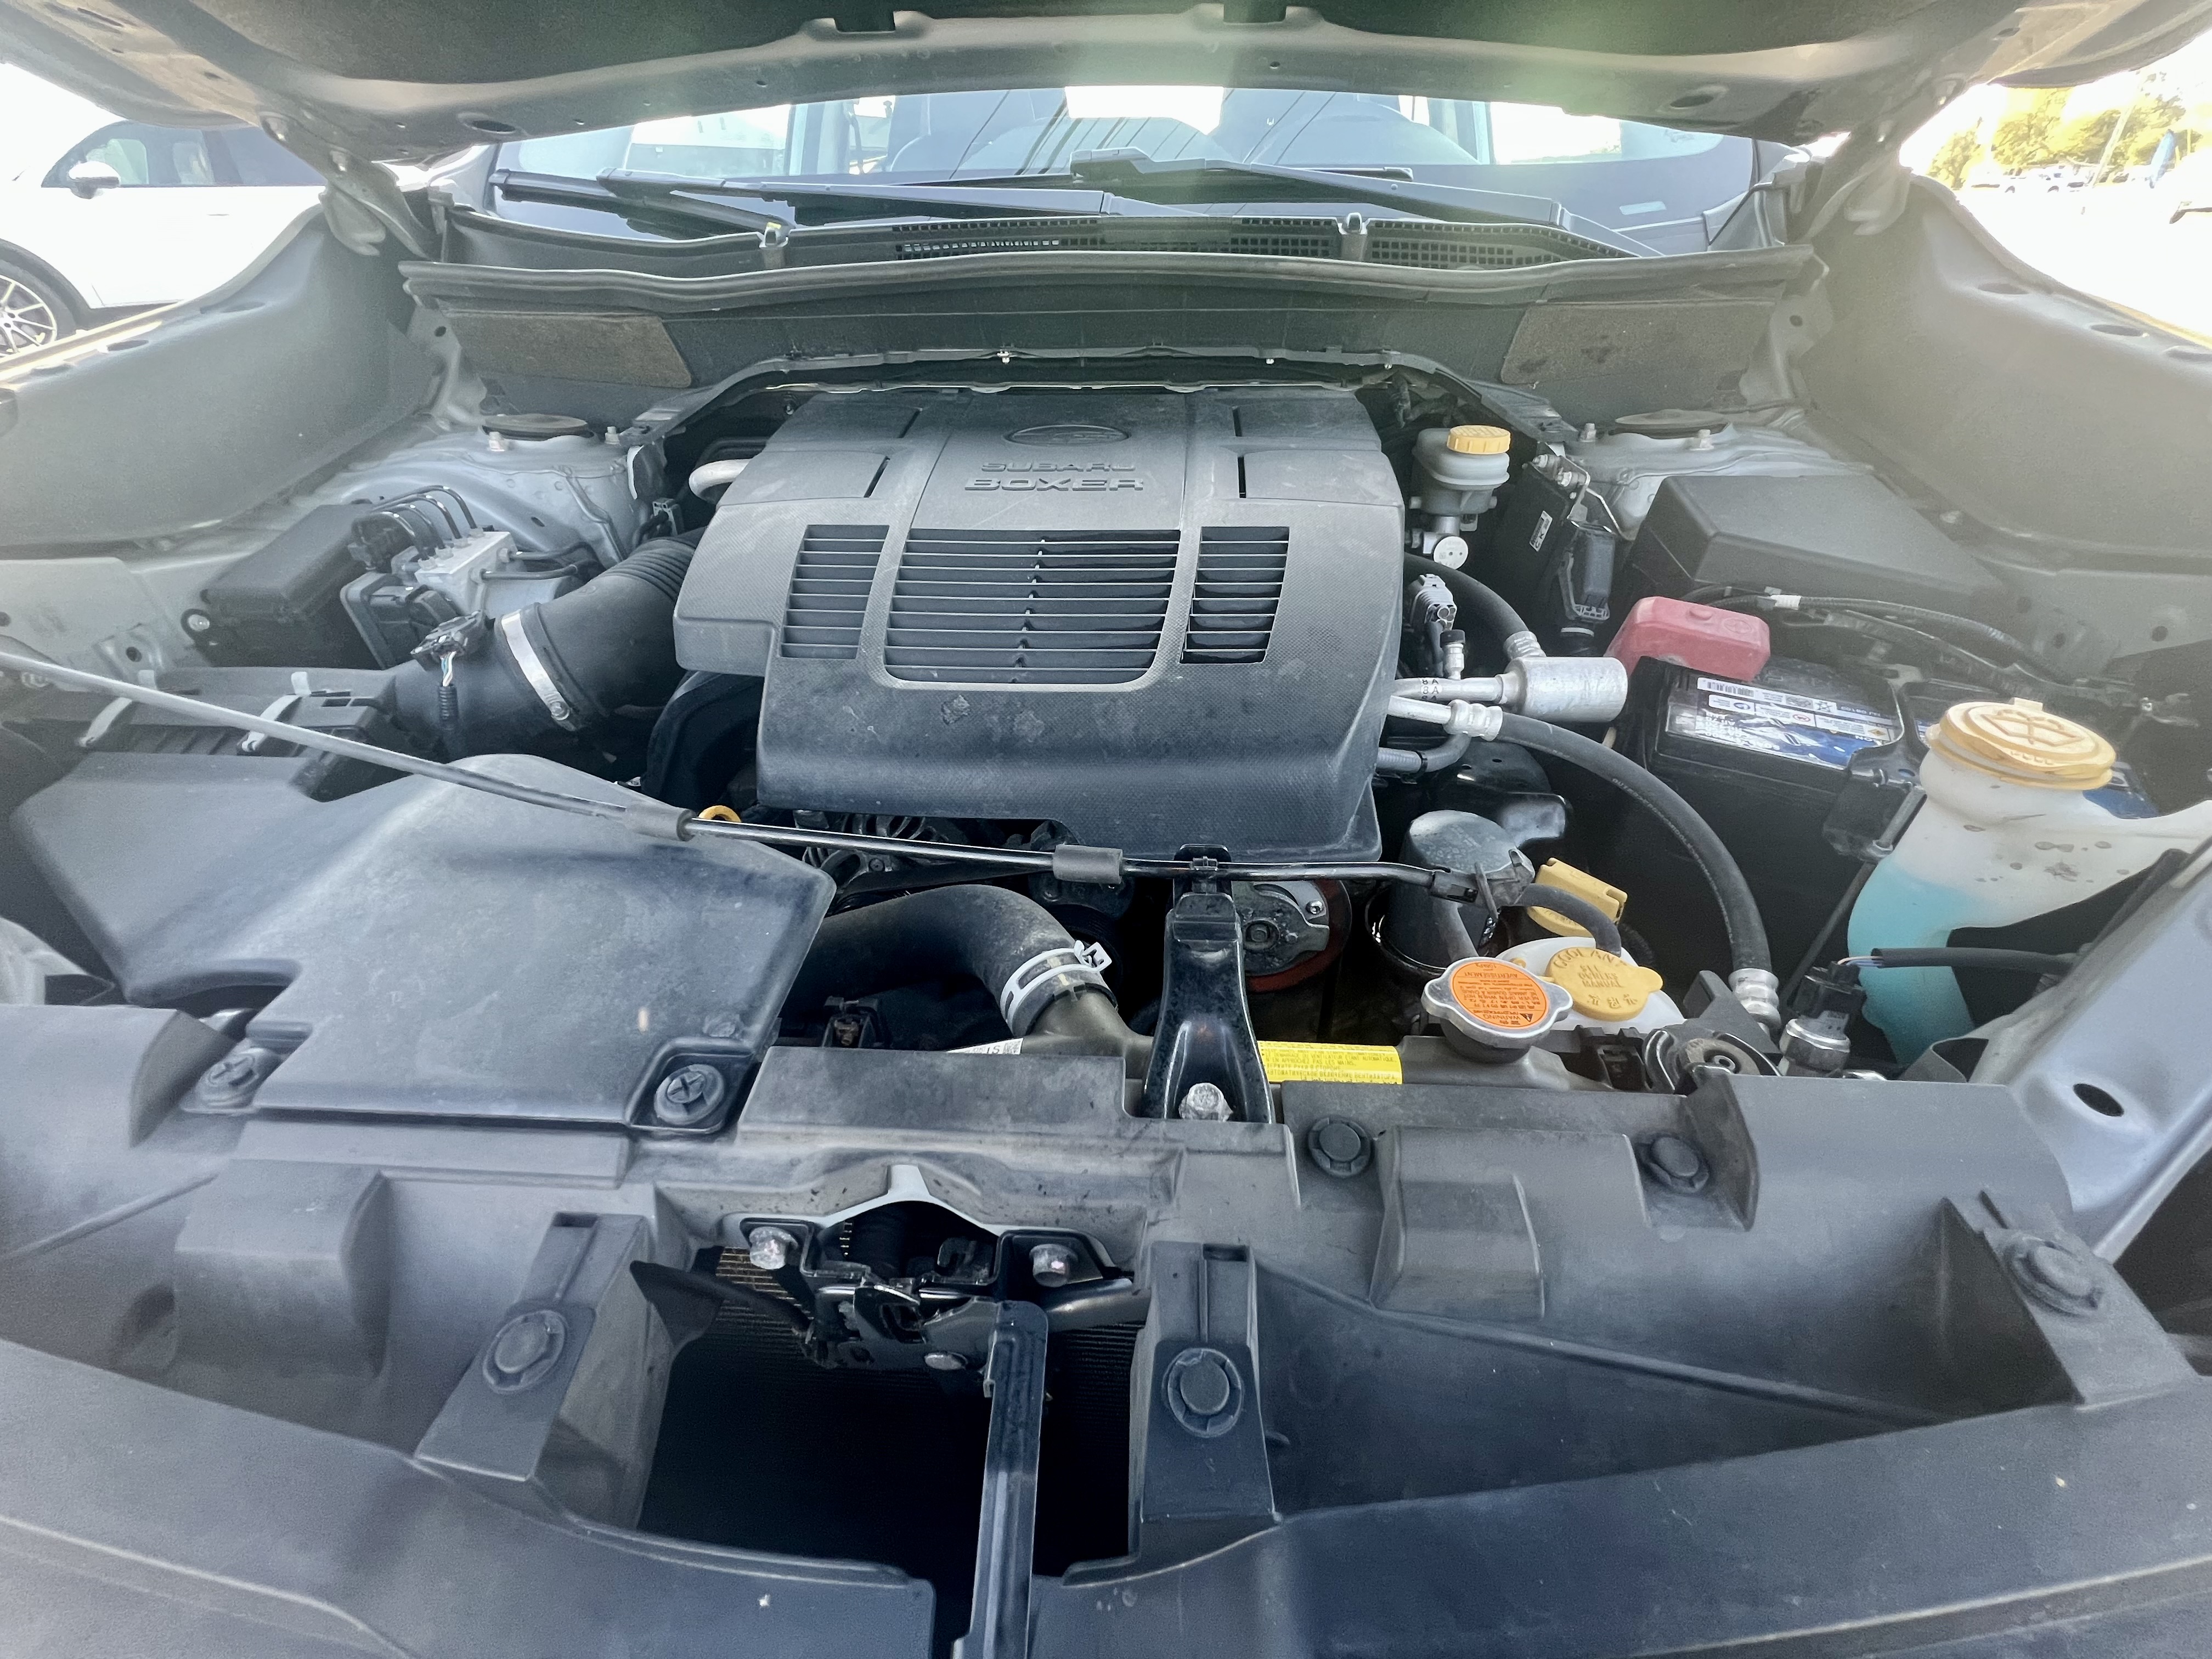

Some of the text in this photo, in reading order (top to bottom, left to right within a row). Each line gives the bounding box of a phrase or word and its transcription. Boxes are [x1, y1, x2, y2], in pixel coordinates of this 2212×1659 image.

[981, 462, 1136, 472] SUBARU
[964, 477, 1143, 491] BOXER
[1582, 980, 1624, 988] MANUAL
